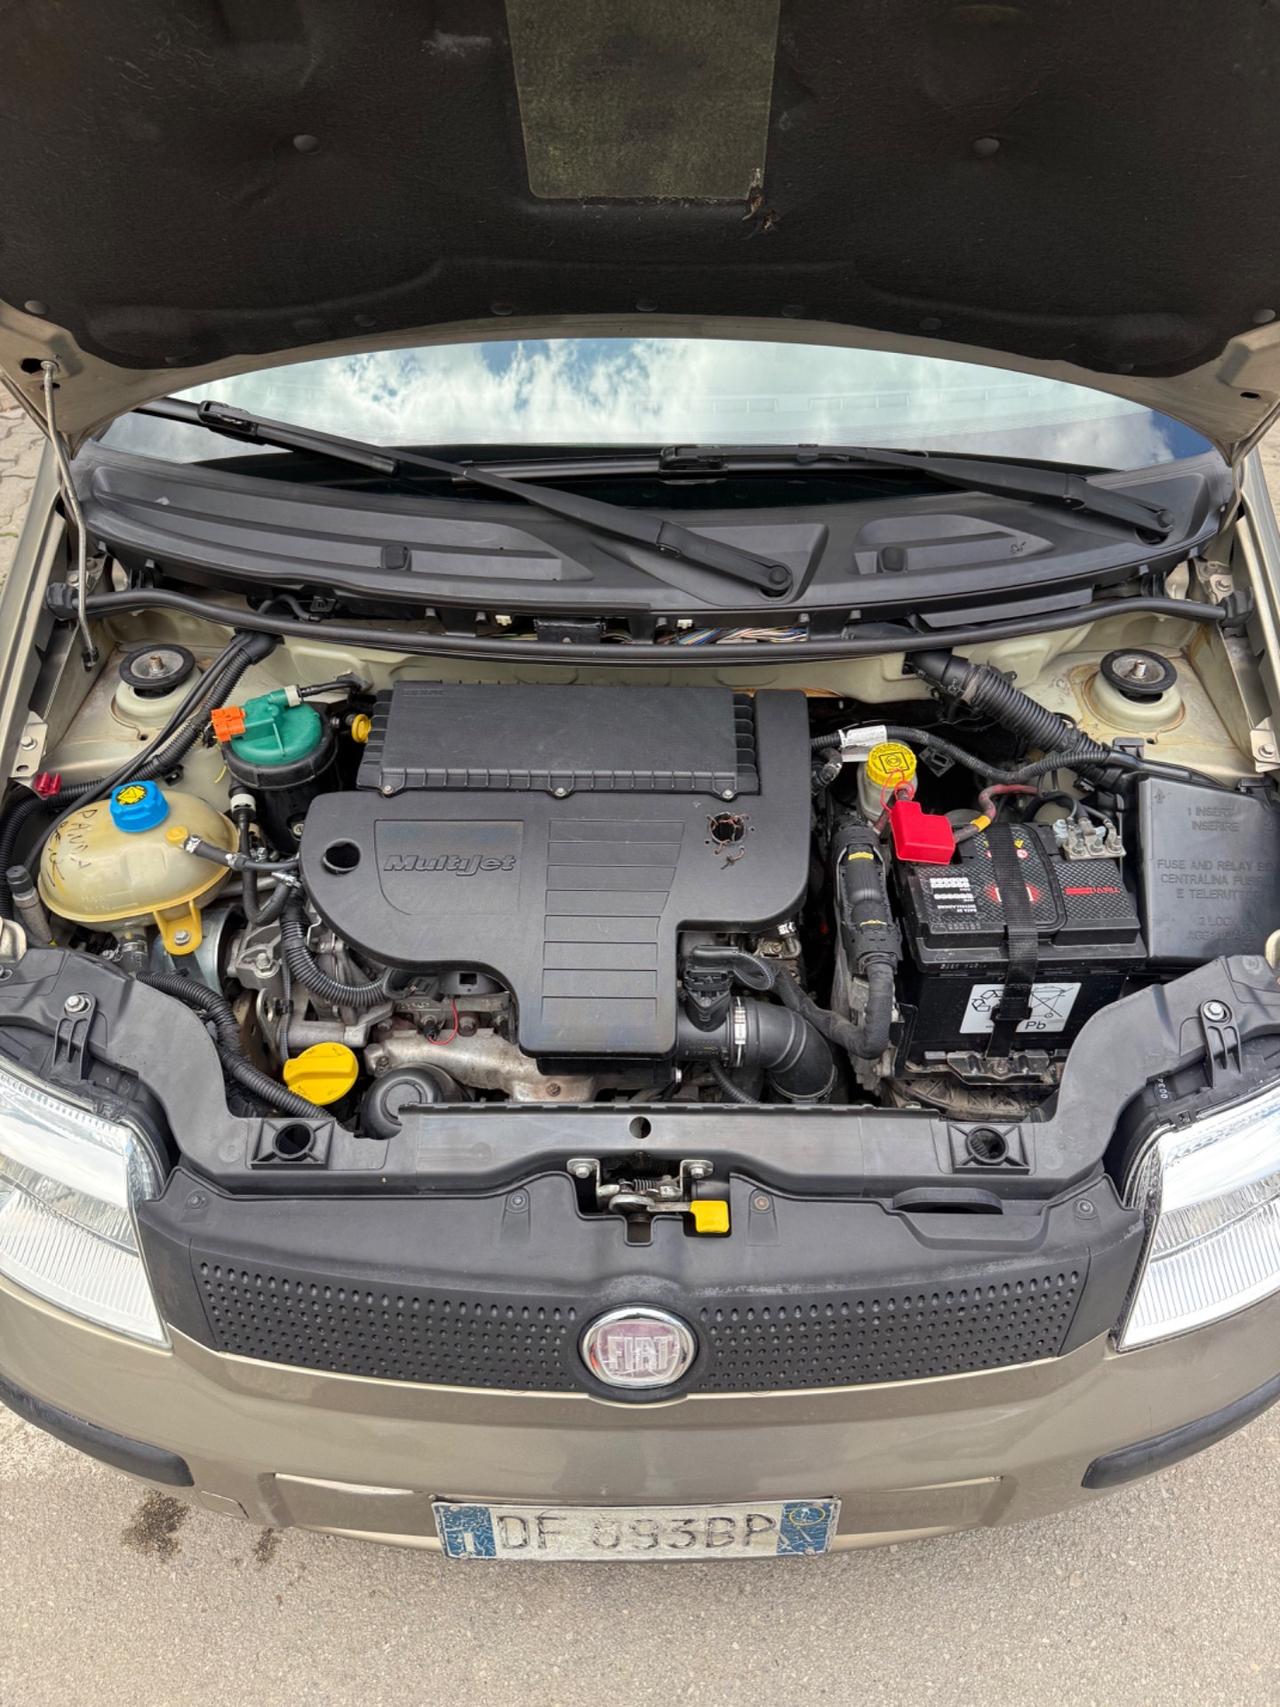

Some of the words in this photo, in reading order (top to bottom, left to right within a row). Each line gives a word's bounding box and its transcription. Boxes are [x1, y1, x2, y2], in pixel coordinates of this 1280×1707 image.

[1157, 859, 1186, 870] FUSE
[1190, 860, 1213, 871] AND
[1217, 860, 1253, 872] RELAY
[1160, 873, 1229, 885] CENTRALINA
[1025, 1020, 1047, 1031] Pb
[607, 1335, 675, 1371] FIAT
[497, 1511, 567, 1551] DF
